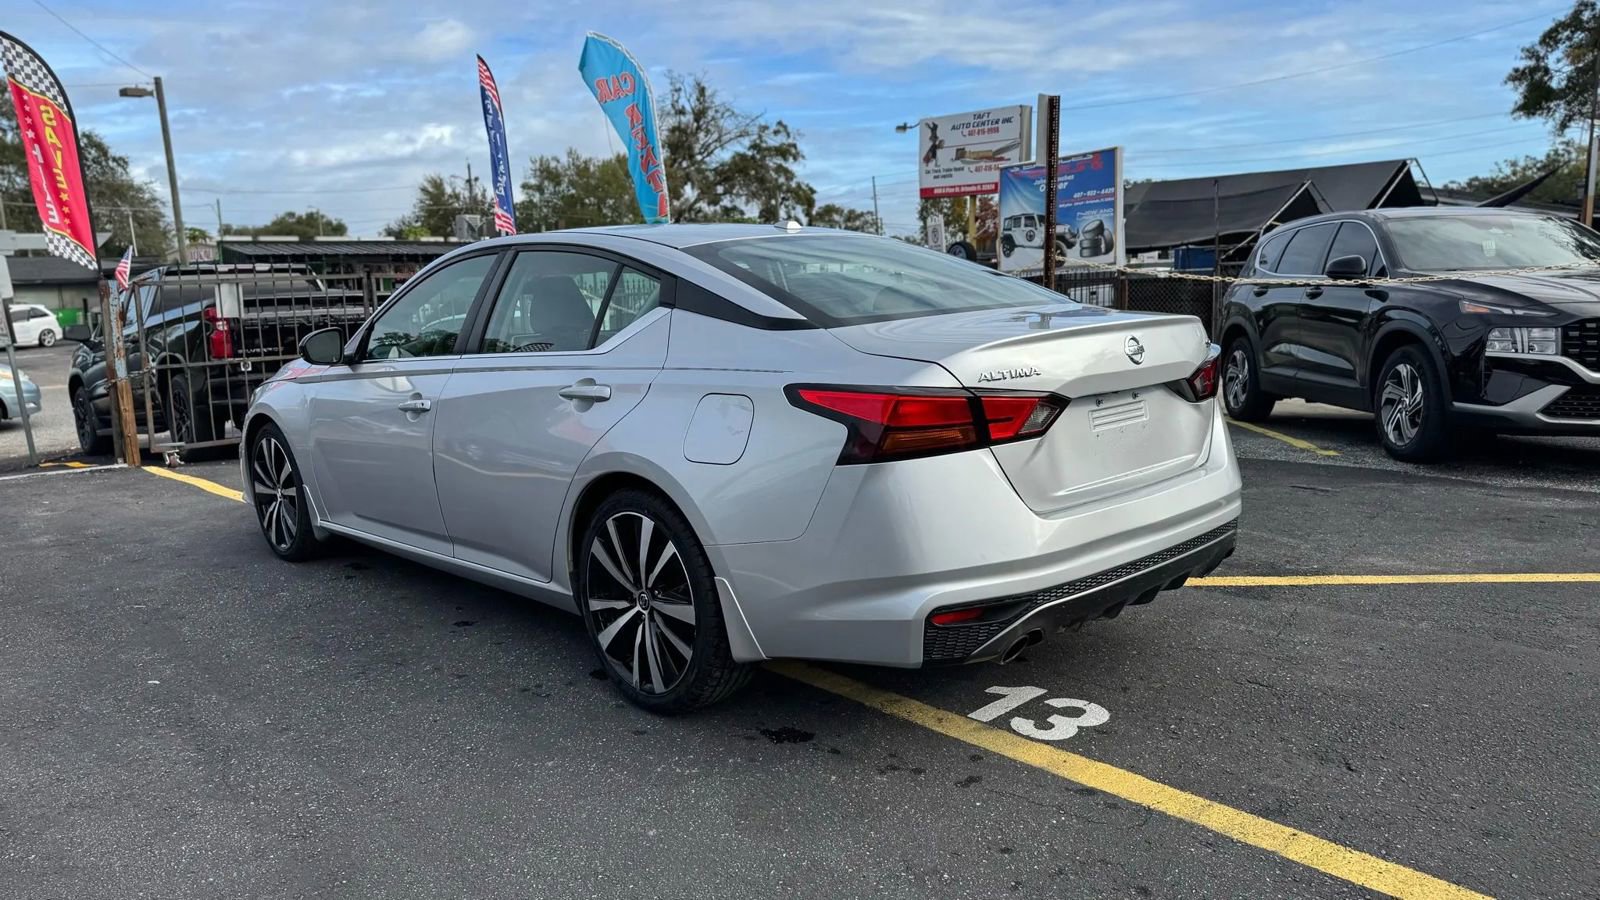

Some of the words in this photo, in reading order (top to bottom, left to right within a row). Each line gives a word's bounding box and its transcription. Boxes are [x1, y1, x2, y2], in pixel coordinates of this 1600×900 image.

[951, 122, 971, 131] AUTO
[972, 118, 1001, 129] CENTER
[1001, 115, 1014, 124] INC
[973, 111, 991, 121] TAFT
[978, 367, 1041, 383] ALTIMA
[967, 686, 1111, 740] 13
